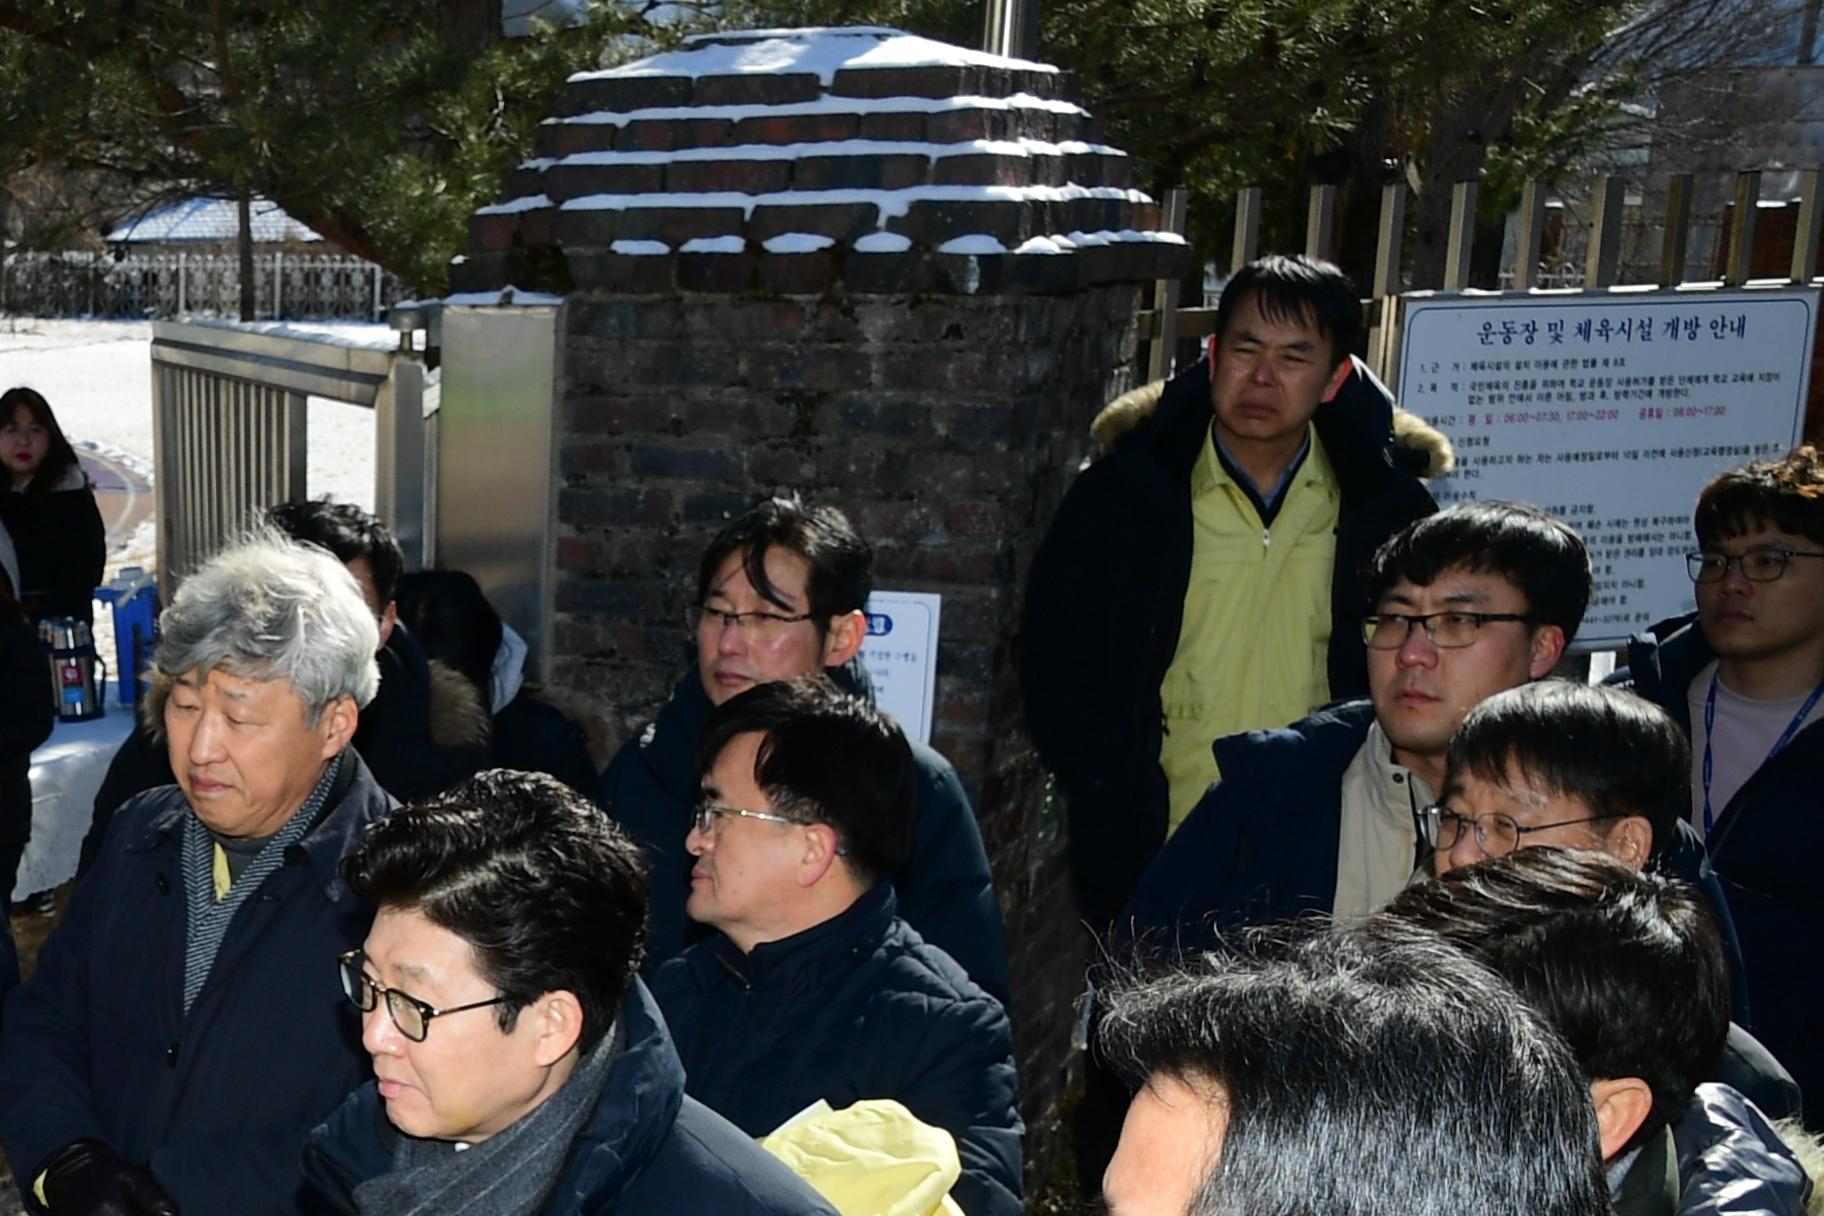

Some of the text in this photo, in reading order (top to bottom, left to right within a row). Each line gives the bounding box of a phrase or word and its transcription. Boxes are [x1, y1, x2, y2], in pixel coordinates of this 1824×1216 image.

[1477, 313, 1747, 345] 운동장 및 체육시설 개방 안내
